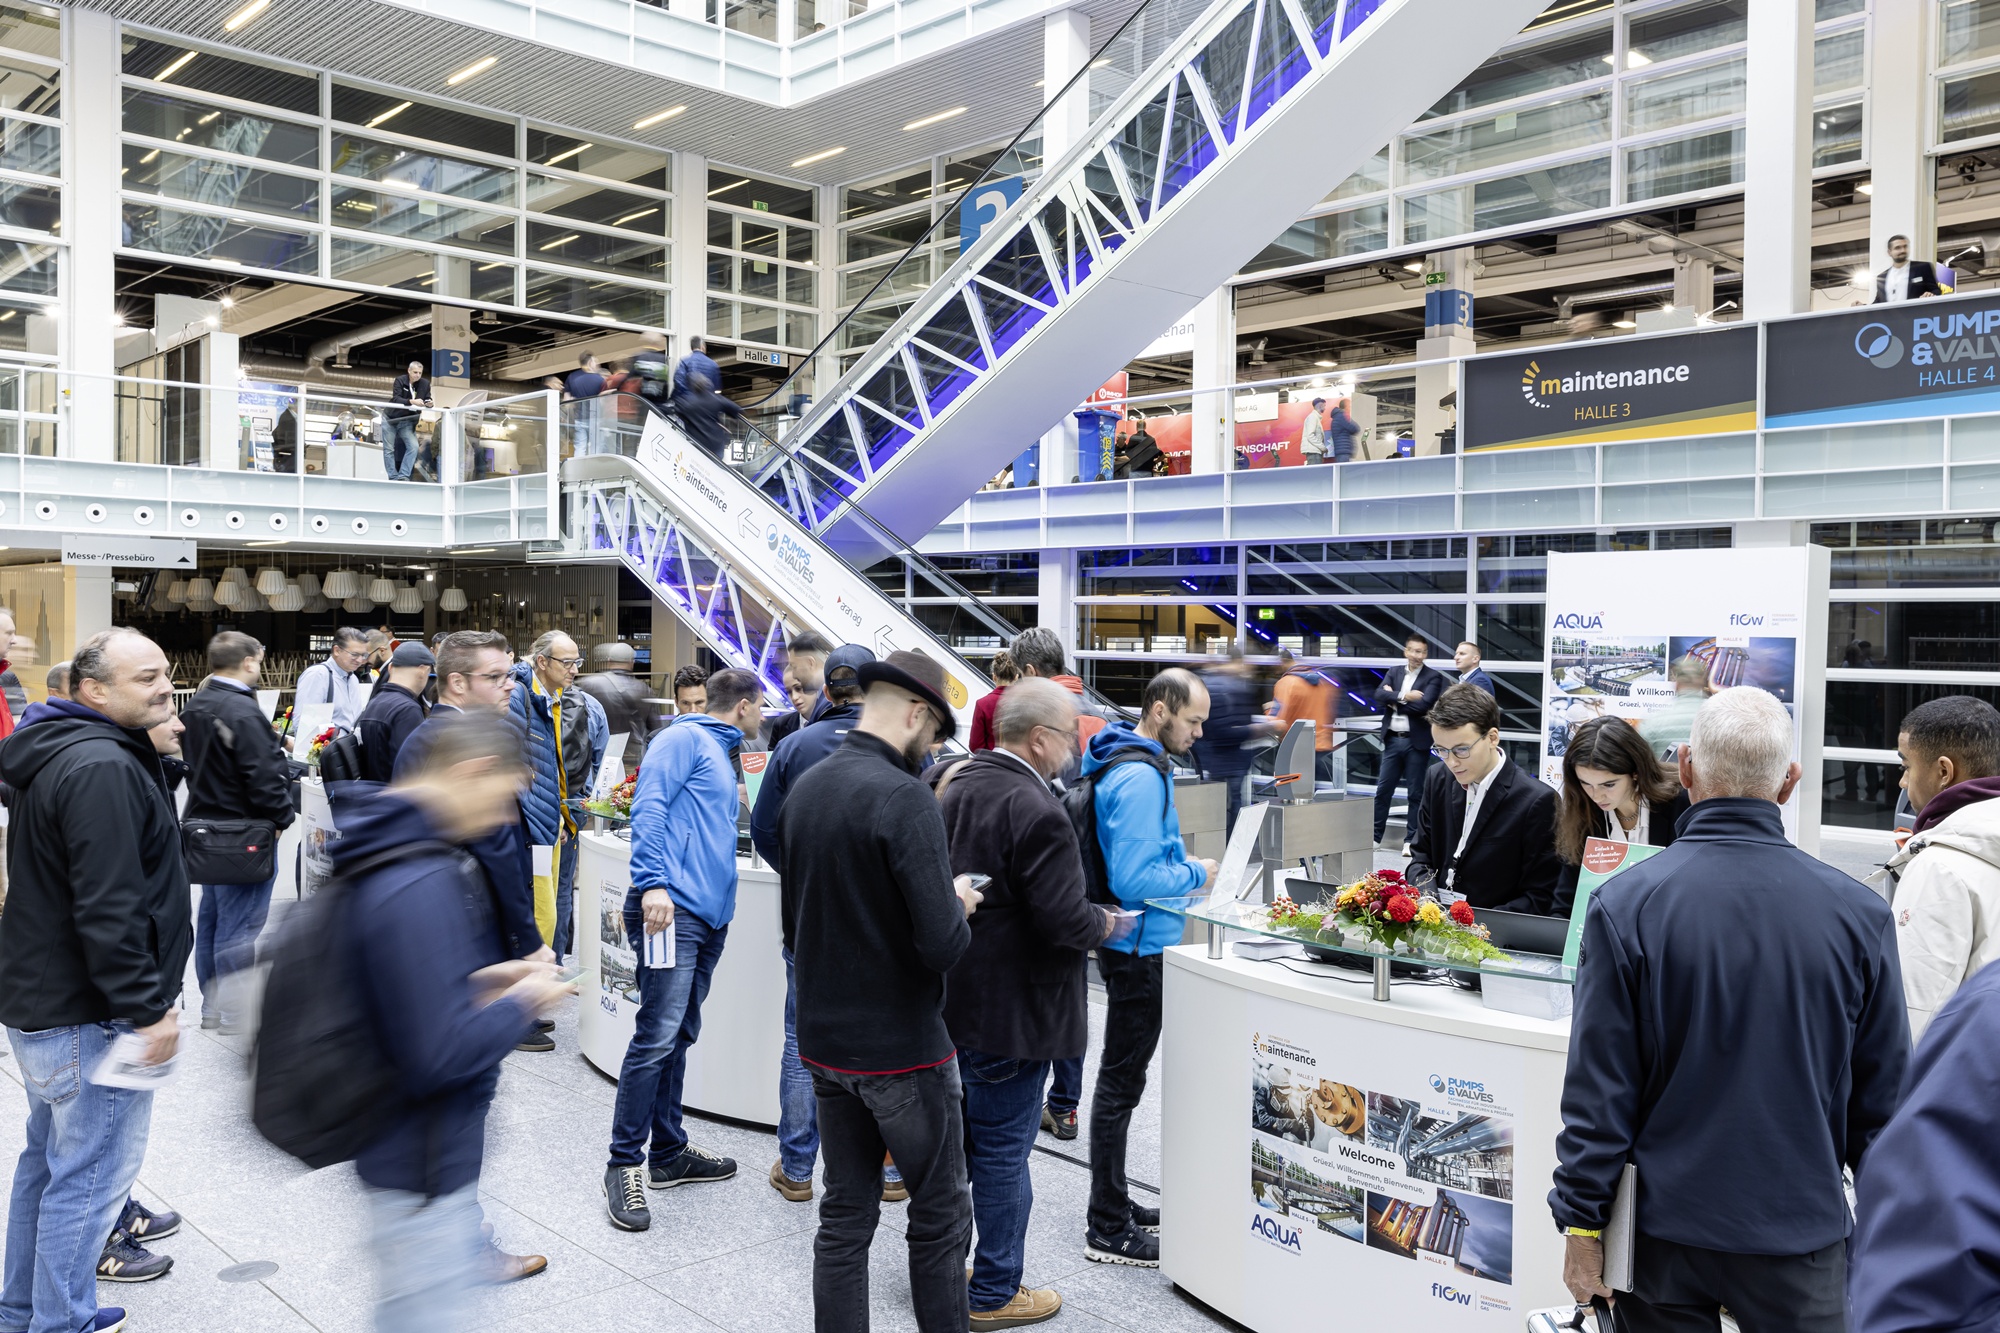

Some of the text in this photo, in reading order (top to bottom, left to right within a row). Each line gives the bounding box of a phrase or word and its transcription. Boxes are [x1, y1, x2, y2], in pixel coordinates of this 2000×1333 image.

[1458, 293, 1470, 324] 3
[1913, 310, 2000, 341] PUMP
[449, 352, 464, 376] 3
[745, 350, 779, 364] Halle 3
[1540, 365, 1690, 395] maintenance
[1919, 366, 1996, 387] HALLE 4
[1574, 403, 1631, 421] HALLE 3
[1234, 441, 1290, 454] ENSCHAFT
[679, 466, 728, 513] maintenance
[67, 552, 155, 562] Messe-/Pressebüro
[781, 534, 811, 566] PUMPS
[1553, 614, 1603, 629] AQUA
[601, 995, 617, 1014] AQUA
[1260, 1044, 1316, 1066] maintenance
[1297, 1072, 1310, 1080] HALLE
[1448, 1077, 1484, 1092] PUMPS
[1448, 1087, 1494, 1103] &VALVES
[1428, 1107, 1446, 1116] HALLE
[1339, 1145, 1396, 1170] Welcome
[1313, 1156, 1425, 1195] Grüezi, Willkommen, Bienvenue,
[1348, 1176, 1385, 1192] Benvenuto
[1292, 1212, 1305, 1221] HALLE
[130, 1217, 150, 1235] N
[1251, 1214, 1301, 1251] AQUA
[99, 1257, 124, 1276] N
[1425, 1256, 1442, 1265] HALLE
[1481, 1301, 1511, 1312] WASSERSTOFF
